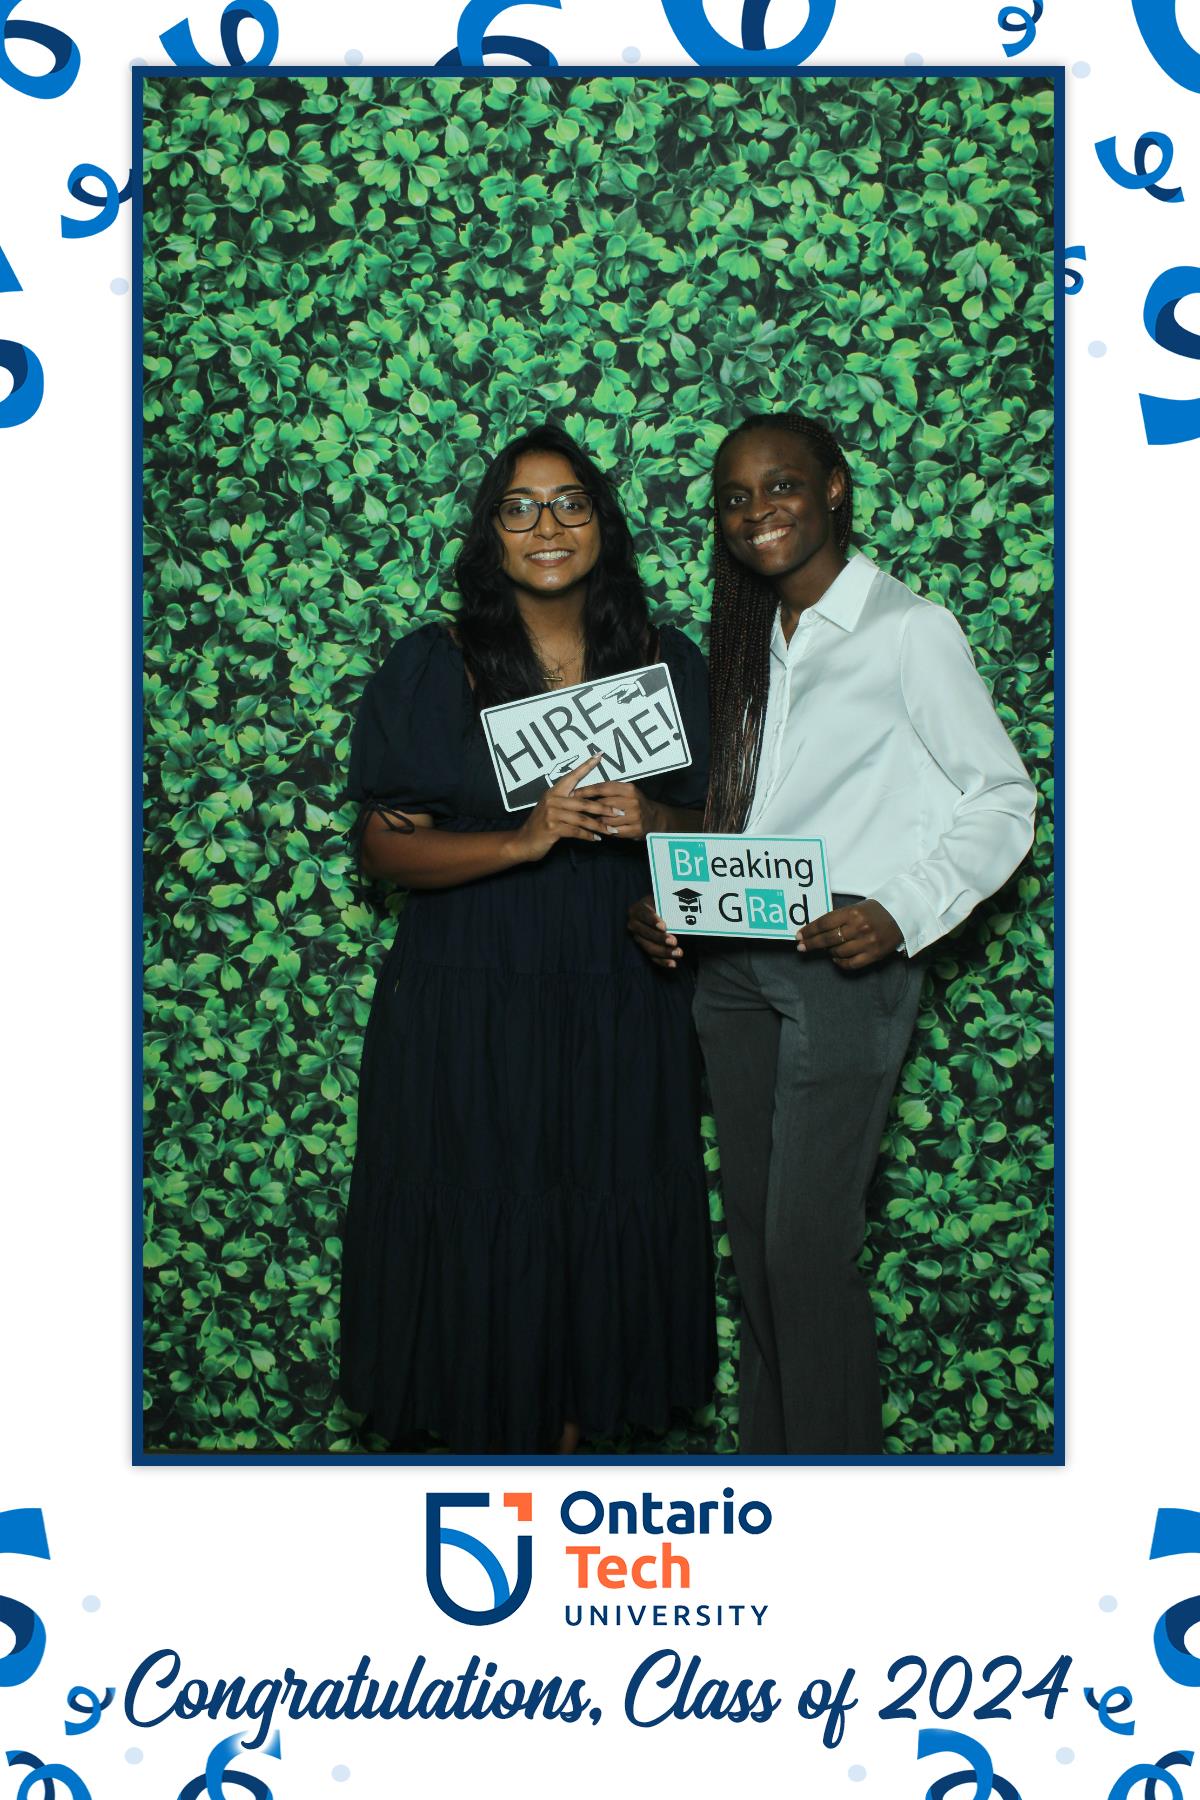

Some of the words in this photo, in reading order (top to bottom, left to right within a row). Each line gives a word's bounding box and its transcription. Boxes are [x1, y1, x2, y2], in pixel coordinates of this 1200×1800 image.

[492, 686, 616, 783] HIRE
[586, 701, 682, 783] ME!
[673, 848, 815, 888] Breaking
[717, 892, 811, 927] GRad
